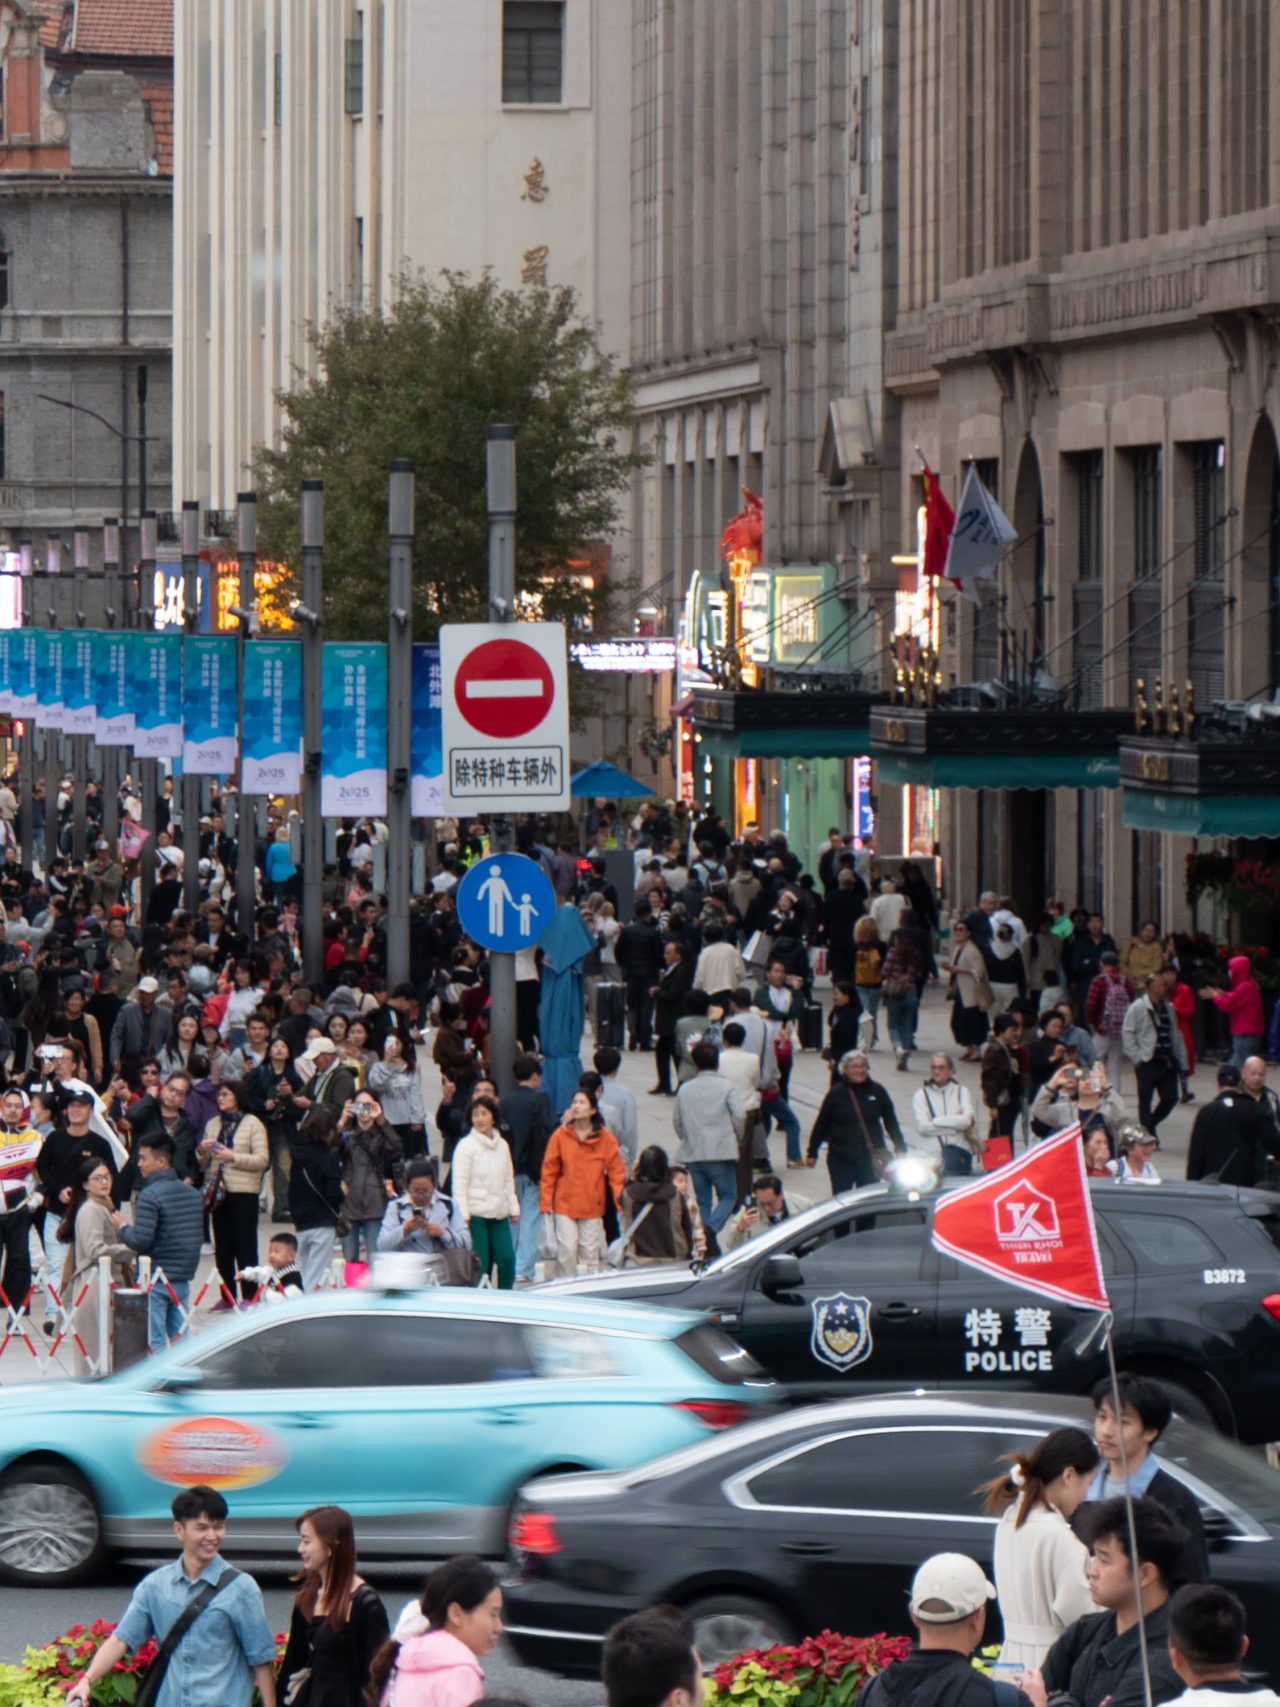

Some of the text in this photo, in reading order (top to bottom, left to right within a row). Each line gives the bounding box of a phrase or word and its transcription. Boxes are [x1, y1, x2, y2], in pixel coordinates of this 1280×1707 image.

[257, 768, 285, 778] 2025
[455, 756, 557, 788] 除特种车辆外
[339, 787, 369, 798] 2025
[964, 1307, 1052, 1347] 特警
[965, 1350, 1053, 1372] POLICE
